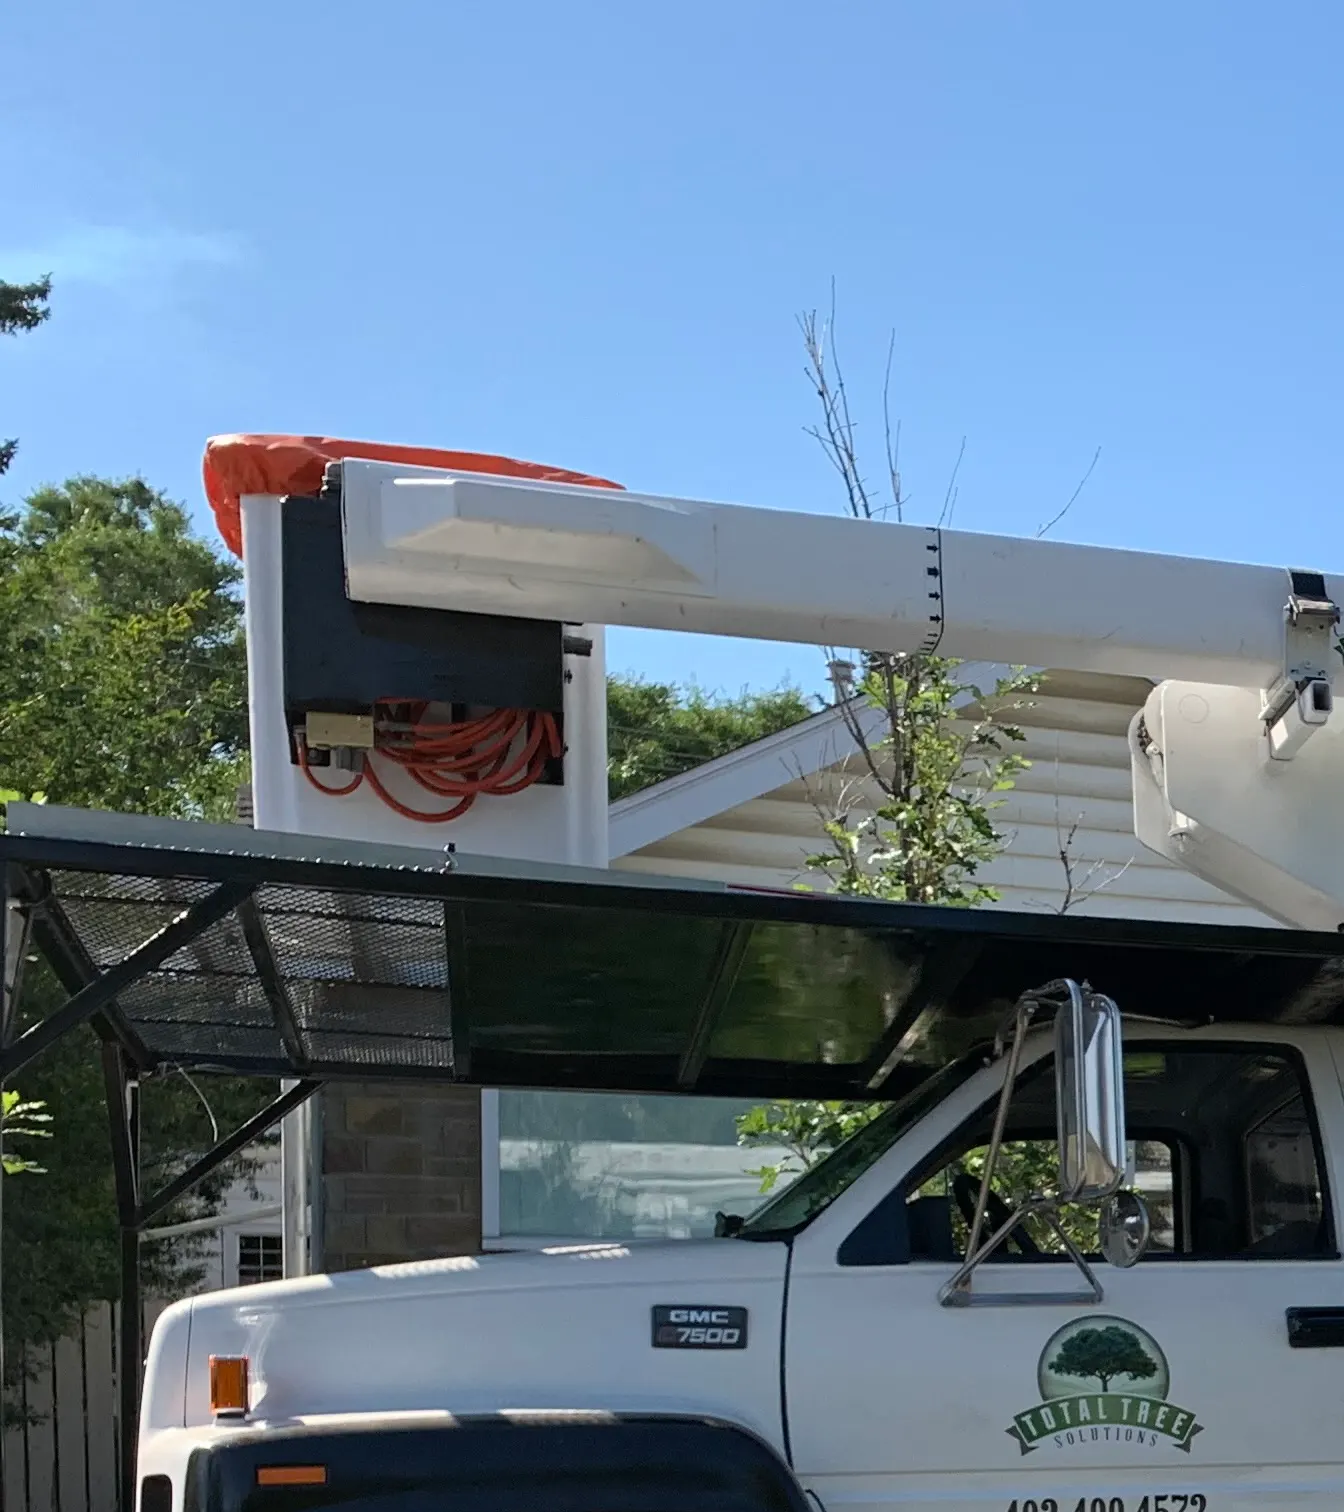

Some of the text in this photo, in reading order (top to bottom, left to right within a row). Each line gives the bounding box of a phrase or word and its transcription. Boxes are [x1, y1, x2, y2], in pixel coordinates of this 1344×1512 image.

[669, 1309, 729, 1324] GMC
[1021, 1397, 1188, 1437] TOTAL TREE
[1053, 1427, 1159, 1449] SOLUTIONS
